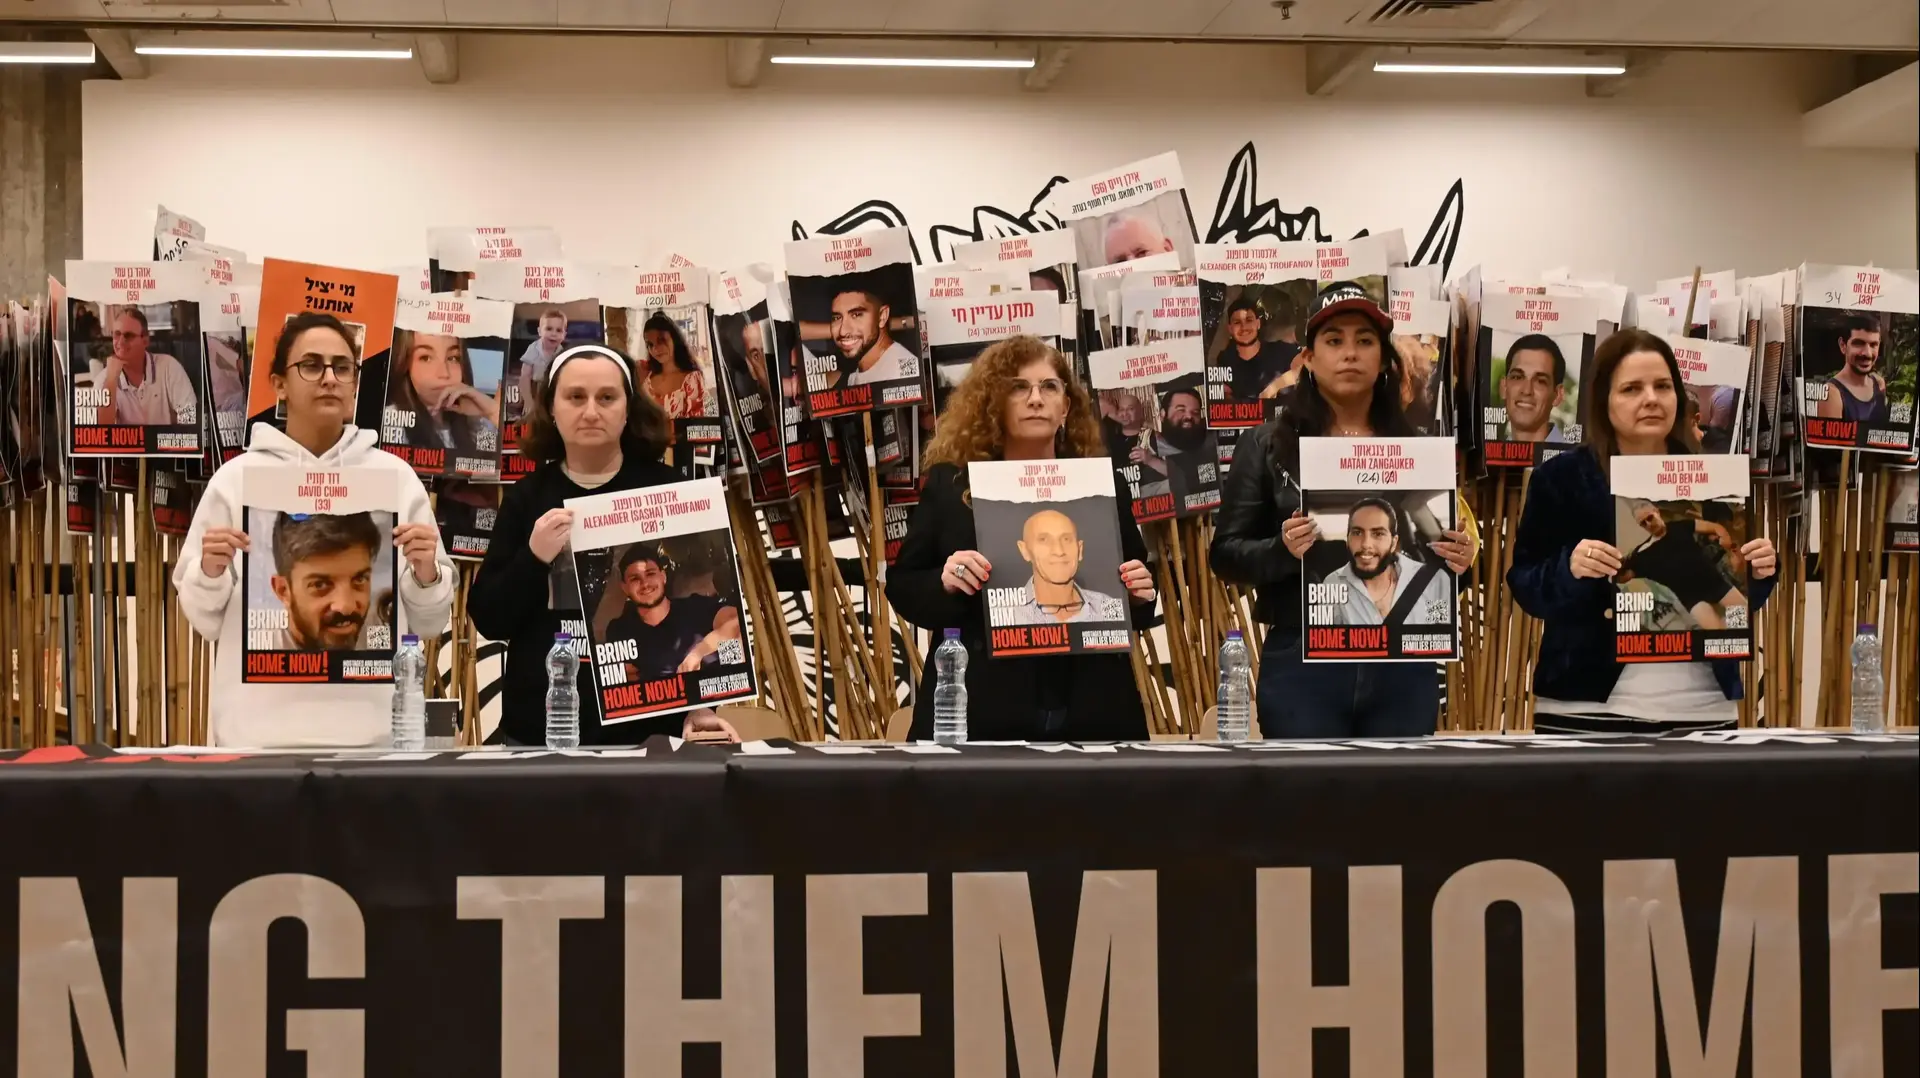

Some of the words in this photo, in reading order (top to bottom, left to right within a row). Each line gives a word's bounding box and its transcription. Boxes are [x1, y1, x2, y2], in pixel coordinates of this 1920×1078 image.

[1091, 181, 1108, 196] (56)
[825, 250, 852, 262] EVYATAR
[853, 247, 872, 258] DAVID
[1320, 257, 1350, 268] WENKERT
[843, 261, 857, 272] (23)
[1200, 263, 1236, 271] ALEXANDER
[1238, 261, 1267, 271] (SASHA)
[1269, 260, 1313, 269] TROUFANOV
[1320, 269, 1333, 280] (22)
[1857, 272, 1867, 283] לוי
[1869, 273, 1880, 284] אור
[110, 279, 128, 289] OHAD
[129, 279, 141, 289] BEN
[142, 279, 156, 289] AMI
[305, 277, 335, 294] יציל
[339, 284, 356, 297] מי
[523, 278, 543, 288] ARIEL
[544, 278, 565, 288] BIBAS
[635, 285, 662, 295] DANIELA
[663, 283, 686, 294] GILBOA
[1853, 283, 1862, 293] OR
[1864, 284, 1881, 295] LEVY
[127, 290, 140, 302] (55)
[539, 288, 550, 300] (4)
[645, 296, 664, 307] (20)
[1825, 291, 1841, 304] 34
[1858, 294, 1873, 306] (33)
[305, 295, 353, 314] אותנו?
[1007, 302, 1034, 322] מתן
[427, 311, 446, 321] AGAM
[447, 312, 470, 323] BERGER
[951, 306, 967, 323] חי
[970, 304, 1003, 325] עדיין
[1515, 310, 1534, 321] DOLEV
[441, 323, 454, 333] (19)
[1530, 321, 1543, 332] (35)
[805, 354, 838, 375] BRING
[1119, 369, 1132, 380] IAIR
[1133, 367, 1146, 379] AND
[1146, 365, 1162, 377] EITAN
[1162, 361, 1178, 373] HORN
[1207, 366, 1233, 382] BRING
[807, 373, 828, 392] HIM
[74, 387, 111, 407] BRING
[810, 390, 840, 411] HOME
[841, 384, 872, 405] NOW!
[1209, 385, 1225, 400] HIM
[1806, 382, 1829, 400] BRING
[739, 393, 763, 416] BRING
[1209, 403, 1233, 419] HOME
[1235, 398, 1263, 418] NOW!
[1806, 400, 1818, 417] HIM
[75, 407, 98, 425] HIM
[384, 408, 416, 428] BRING
[1484, 407, 1506, 424] BRING
[744, 415, 756, 434] OZ
[1484, 424, 1498, 440] HIM
[1807, 420, 1824, 436] HOME
[1825, 420, 1858, 439] NOW!
[74, 427, 109, 446] HOME
[111, 425, 145, 446] NOW!
[382, 427, 402, 444] HER
[785, 425, 798, 444] HIM
[157, 439, 180, 449] FAMILIES
[180, 439, 198, 449] FORUM
[1387, 445, 1401, 456] מתן
[1485, 442, 1504, 458] HOME
[1504, 442, 1534, 459] NOW!
[382, 446, 411, 463] HOME
[413, 448, 445, 467] NOW!
[1340, 458, 1367, 469] MATAN
[1368, 458, 1414, 470] ZANGAUKER
[1662, 460, 1675, 472] עמי
[1677, 460, 1684, 473] בן
[1687, 460, 1704, 472] אוהד
[328, 472, 341, 484] דוד
[1018, 477, 1036, 487] YAIR
[1037, 476, 1066, 487] YAAKOV
[1356, 472, 1380, 484] (24)
[1657, 473, 1678, 484] OHAD
[1679, 473, 1693, 484] BEN
[1694, 473, 1709, 484] AMI
[298, 485, 322, 497] DAVID
[324, 486, 348, 497] CUNIO
[645, 490, 678, 506] אלכסנדר
[1036, 487, 1052, 499] (59)
[1675, 485, 1691, 497] (55)
[314, 498, 331, 511] (33)
[612, 495, 643, 511] טרופנוב
[583, 512, 630, 529] ALEXANDER
[630, 506, 664, 523] (SASHA)
[664, 498, 712, 515] TROUFANOV
[987, 587, 1027, 607] BRING
[1308, 583, 1348, 603] BRING
[1616, 592, 1654, 612] BRING
[247, 609, 289, 630] BRING
[989, 607, 1016, 627] HIM
[1308, 605, 1334, 625] HIM
[1616, 612, 1641, 632] HIM
[247, 629, 275, 650] HIM
[991, 628, 1029, 648] HOME
[1031, 623, 1069, 646] NOW!
[1083, 637, 1108, 647] FAMILIES
[1108, 636, 1129, 647] FORUM
[1308, 628, 1346, 649] HOME
[1349, 625, 1389, 649] NOW!
[1616, 634, 1652, 654] HOME
[1655, 631, 1692, 653] NOW!
[595, 638, 639, 665] BRING
[1402, 641, 1429, 651] FAMILIES
[1429, 641, 1451, 651] FORUM
[1704, 645, 1729, 655] FAMILIES
[1729, 645, 1750, 654] FORUM
[247, 653, 286, 674] HOME
[289, 650, 329, 674] NOW!
[343, 666, 370, 677] FAMILIES
[370, 666, 393, 677] FORUM
[598, 663, 628, 687] HIM
[603, 683, 642, 711] HOME
[644, 674, 686, 700] NOW!
[700, 683, 727, 698] FAMILIES
[727, 680, 750, 692] FORUM
[18, 872, 366, 1078] NG
[456, 868, 1160, 1078] THEM
[1256, 851, 1919, 1078] HOME
